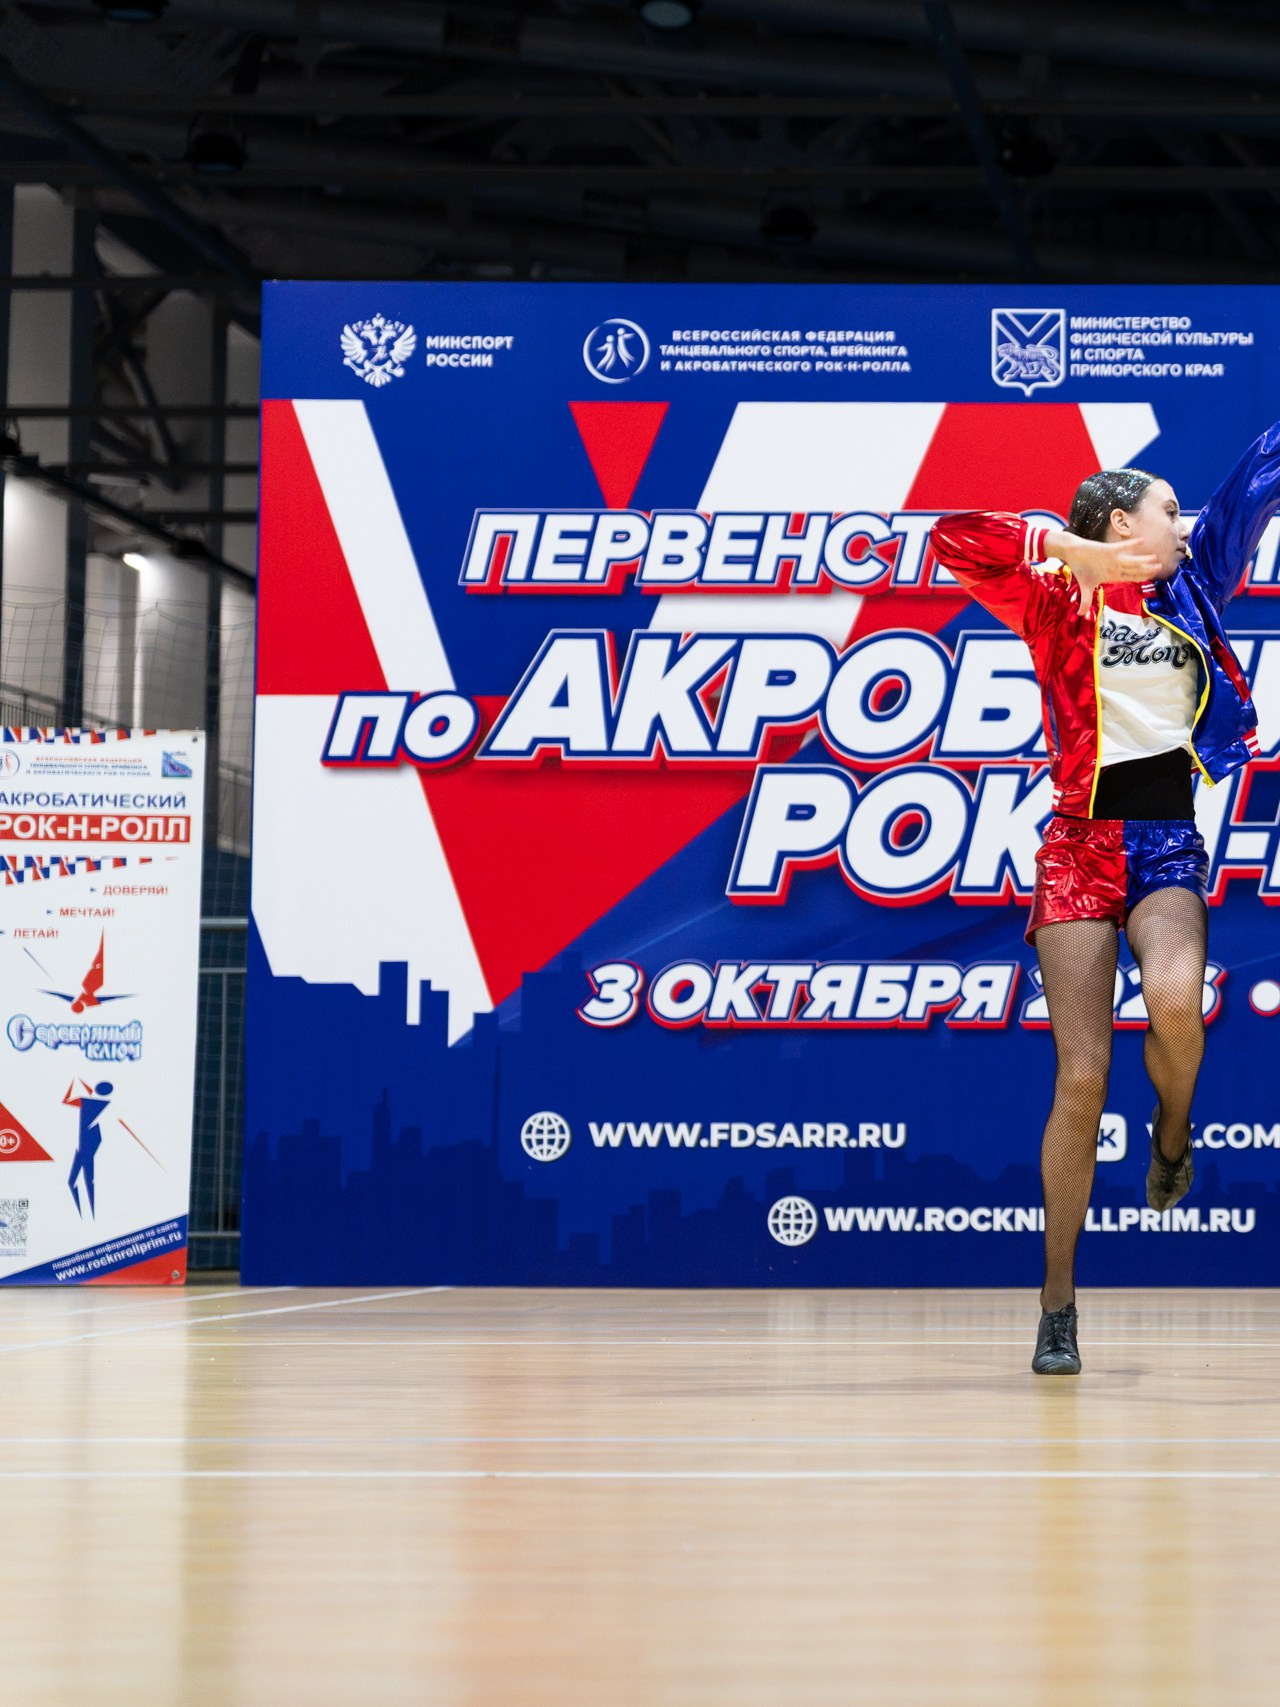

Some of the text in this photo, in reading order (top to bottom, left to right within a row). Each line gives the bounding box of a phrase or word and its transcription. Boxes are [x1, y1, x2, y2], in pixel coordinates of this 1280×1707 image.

[1069, 316, 1192, 330] МИНИСТЕРСТВО
[426, 335, 514, 350] МИНСПОРТ
[672, 329, 896, 342] ВСЕРОССИЙСКАЯ ФЕДЕРАЦИЯ
[1069, 330, 1254, 346] ФИЗИЧЕСКОЙ КУЛЬТУРЫ
[659, 344, 908, 358] ТАНЦЕВАЛЬНОГО СПОРТА, БРЕЙКИНГА
[1070, 347, 1146, 361] И СПОРТА
[426, 353, 493, 367] РОССИИ
[660, 360, 912, 372] И АКРОБАТИЧЕСКОГО РОК-Н-РОЛЛА
[1069, 363, 1225, 377] ПРИМОРСКОГО КРАЯ
[463, 508, 1071, 588] ПЕРВЕНСТ
[0, 791, 187, 809] АКРОБАТИЧЕСКИЙ
[0, 814, 187, 841] РОК-Н-РОЛЛ
[103, 885, 169, 896] ДОВЕРЯЙ!
[59, 907, 116, 918] МЕЧТАЙ!
[13, 928, 60, 939] ЛЕТАЙ!
[579, 961, 641, 1027] 3
[647, 961, 1020, 1028] ОКТЯБРЯ
[588, 1121, 908, 1150] WWW.FDSARR.RU
[824, 1206, 1256, 1234] WWW.ROCKNLLPRIM.RU
[55, 1230, 182, 1282] www.rocknrollprim.ru
